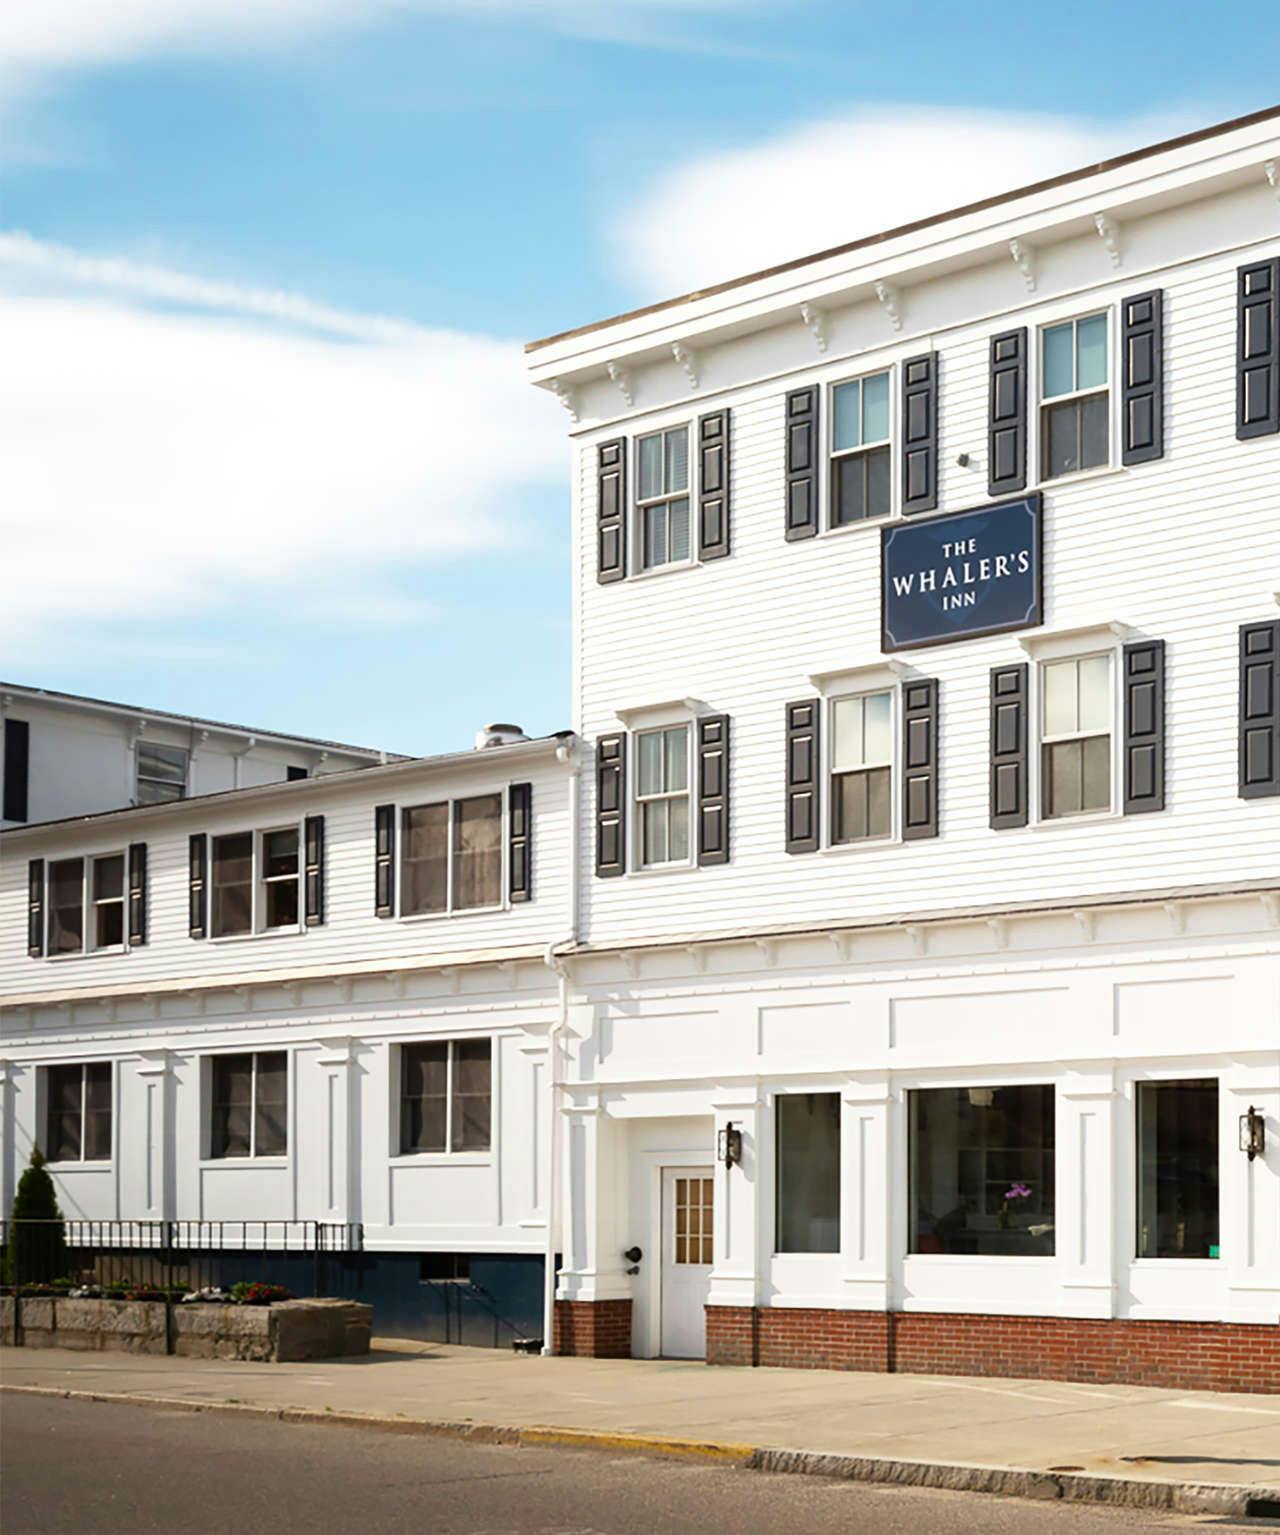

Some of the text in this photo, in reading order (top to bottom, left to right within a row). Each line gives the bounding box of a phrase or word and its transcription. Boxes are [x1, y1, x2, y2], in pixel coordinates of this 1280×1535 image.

[942, 538, 976, 558] THE
[892, 550, 1029, 597] WHALER'S
[943, 591, 976, 610] INN
